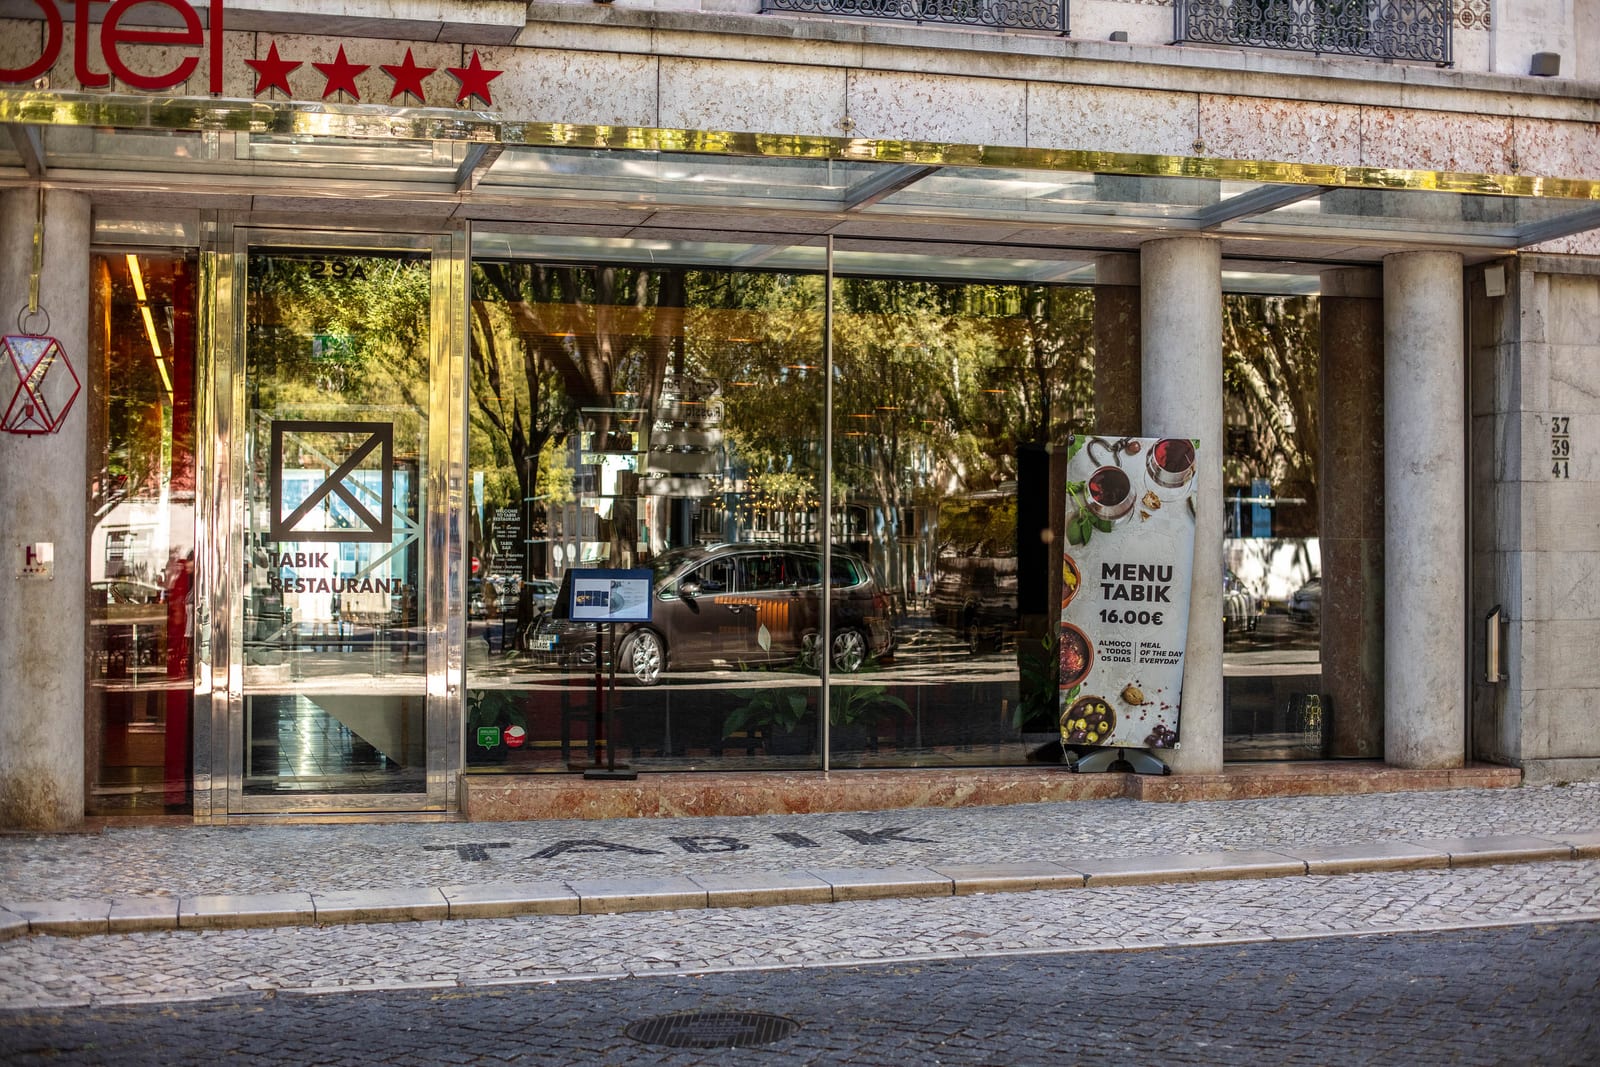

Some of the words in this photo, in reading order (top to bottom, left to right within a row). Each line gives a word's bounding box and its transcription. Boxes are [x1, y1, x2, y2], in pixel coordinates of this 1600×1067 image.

[310, 261, 368, 281] 29A
[1552, 416, 1570, 434] 37
[1552, 439, 1570, 457] 39
[1552, 461, 1570, 479] 41
[269, 552, 329, 568] TABIK
[1101, 563, 1173, 583] MENU
[271, 577, 402, 594] RESTAURANT
[1100, 583, 1171, 603] TABIK
[1099, 609, 1164, 626] 16.00€
[1098, 640, 1132, 648] ALMOÇO
[423, 827, 939, 862] TABIK
